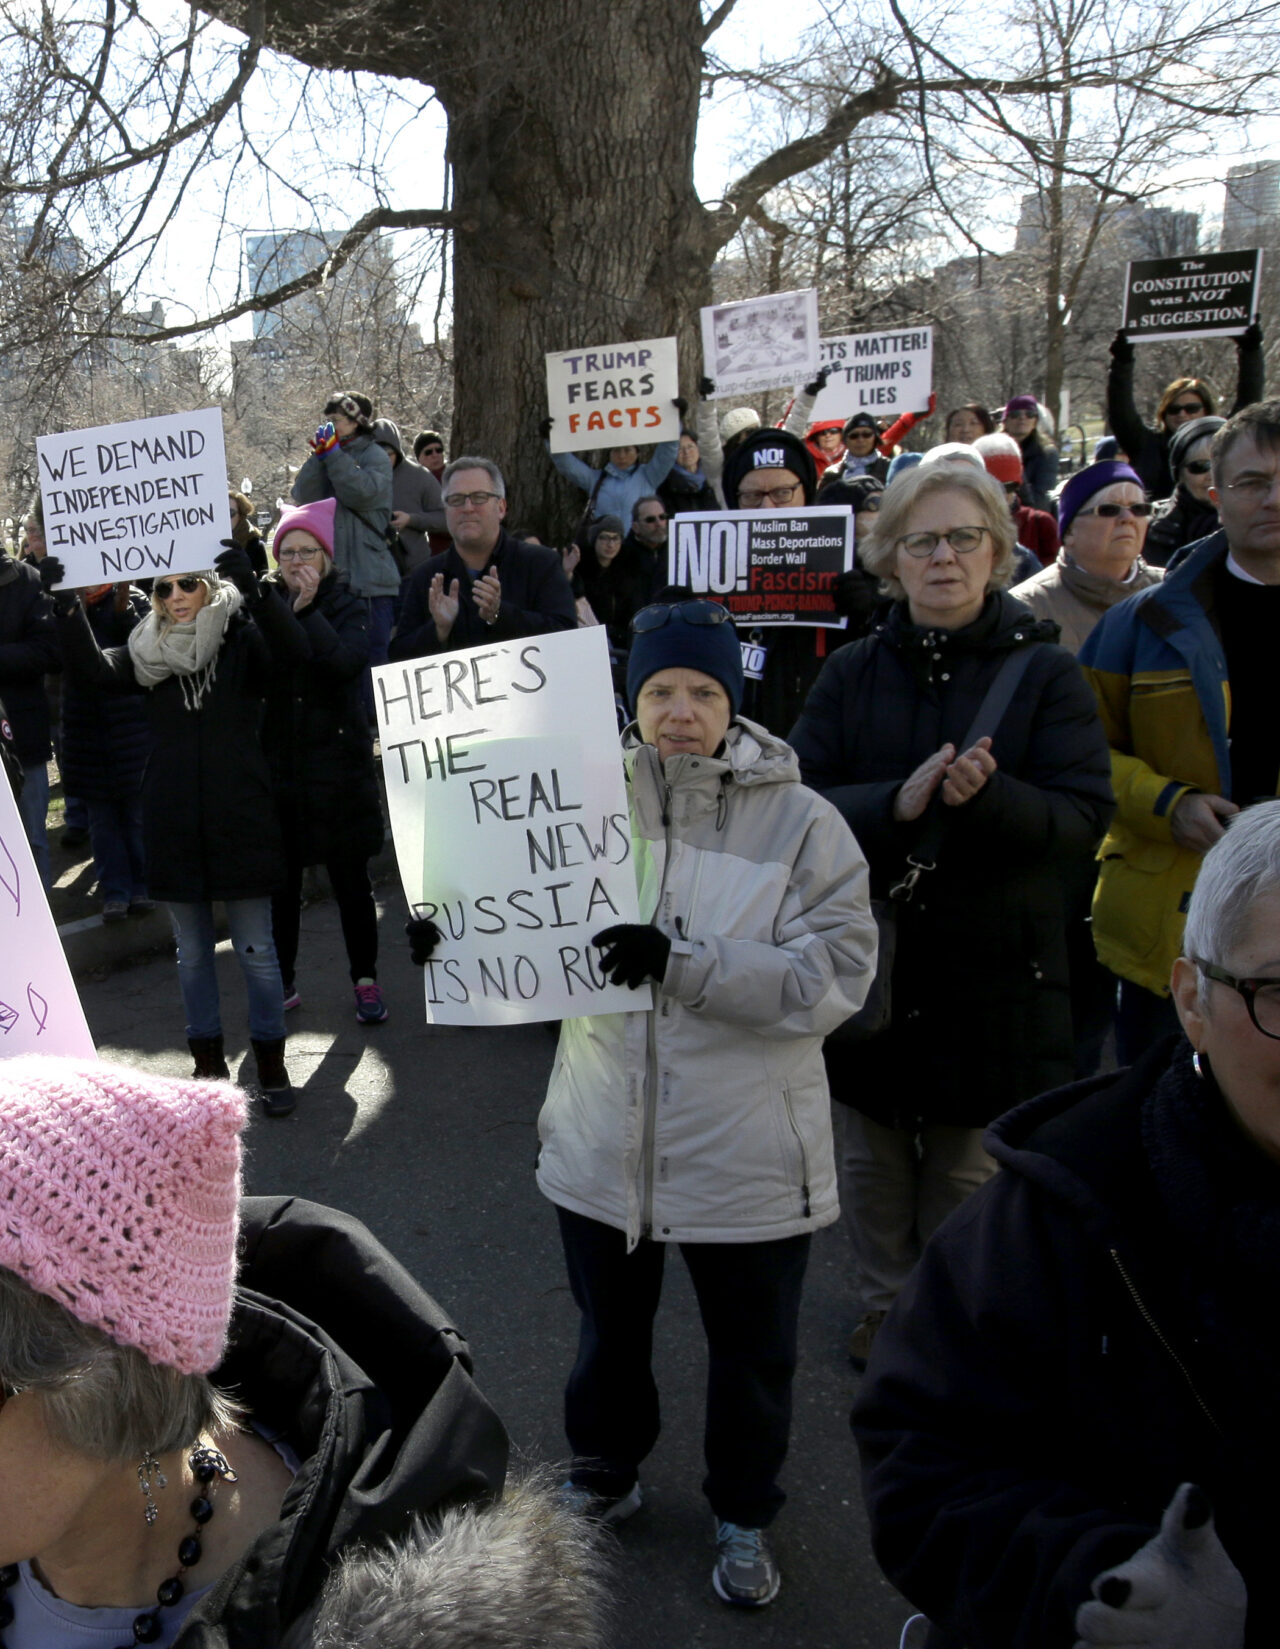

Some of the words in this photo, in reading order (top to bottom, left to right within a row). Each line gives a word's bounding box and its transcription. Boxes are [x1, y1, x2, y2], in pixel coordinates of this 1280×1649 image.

[1181, 261, 1205, 271] The
[1132, 270, 1253, 293] CONSTITUTION
[1150, 296, 1183, 306] was
[1186, 288, 1231, 303] NOT
[1128, 319, 1137, 328] a
[1140, 306, 1248, 327] SUGGESTION.
[854, 331, 928, 358] MATTER!
[563, 349, 652, 375] TRUMP
[844, 360, 912, 384] TRUMPS
[567, 373, 654, 404] FEARS
[859, 386, 897, 406] LIES
[569, 406, 661, 433] FACTS
[41, 446, 87, 482] WE
[97, 430, 206, 475] DEMAND
[754, 448, 784, 466] NO!
[47, 473, 204, 516] INDEPENDENT
[50, 503, 214, 546] INVESTIGATION
[752, 521, 787, 532] Muslim
[790, 520, 808, 531] Ban
[751, 537, 776, 549] Mass
[779, 536, 842, 549] Deportations
[100, 539, 175, 576] NOW
[677, 521, 749, 593] NO!
[751, 554, 783, 565] Border
[785, 552, 806, 564] Wall
[378, 645, 547, 726] HERE'S
[387, 728, 490, 784] THE
[469, 768, 583, 824] REAL
[526, 813, 631, 875] NEWS
[411, 877, 619, 942] RUSSIA
[425, 958, 470, 1005] IS
[478, 954, 539, 1001] NO
[559, 945, 620, 996] RU
